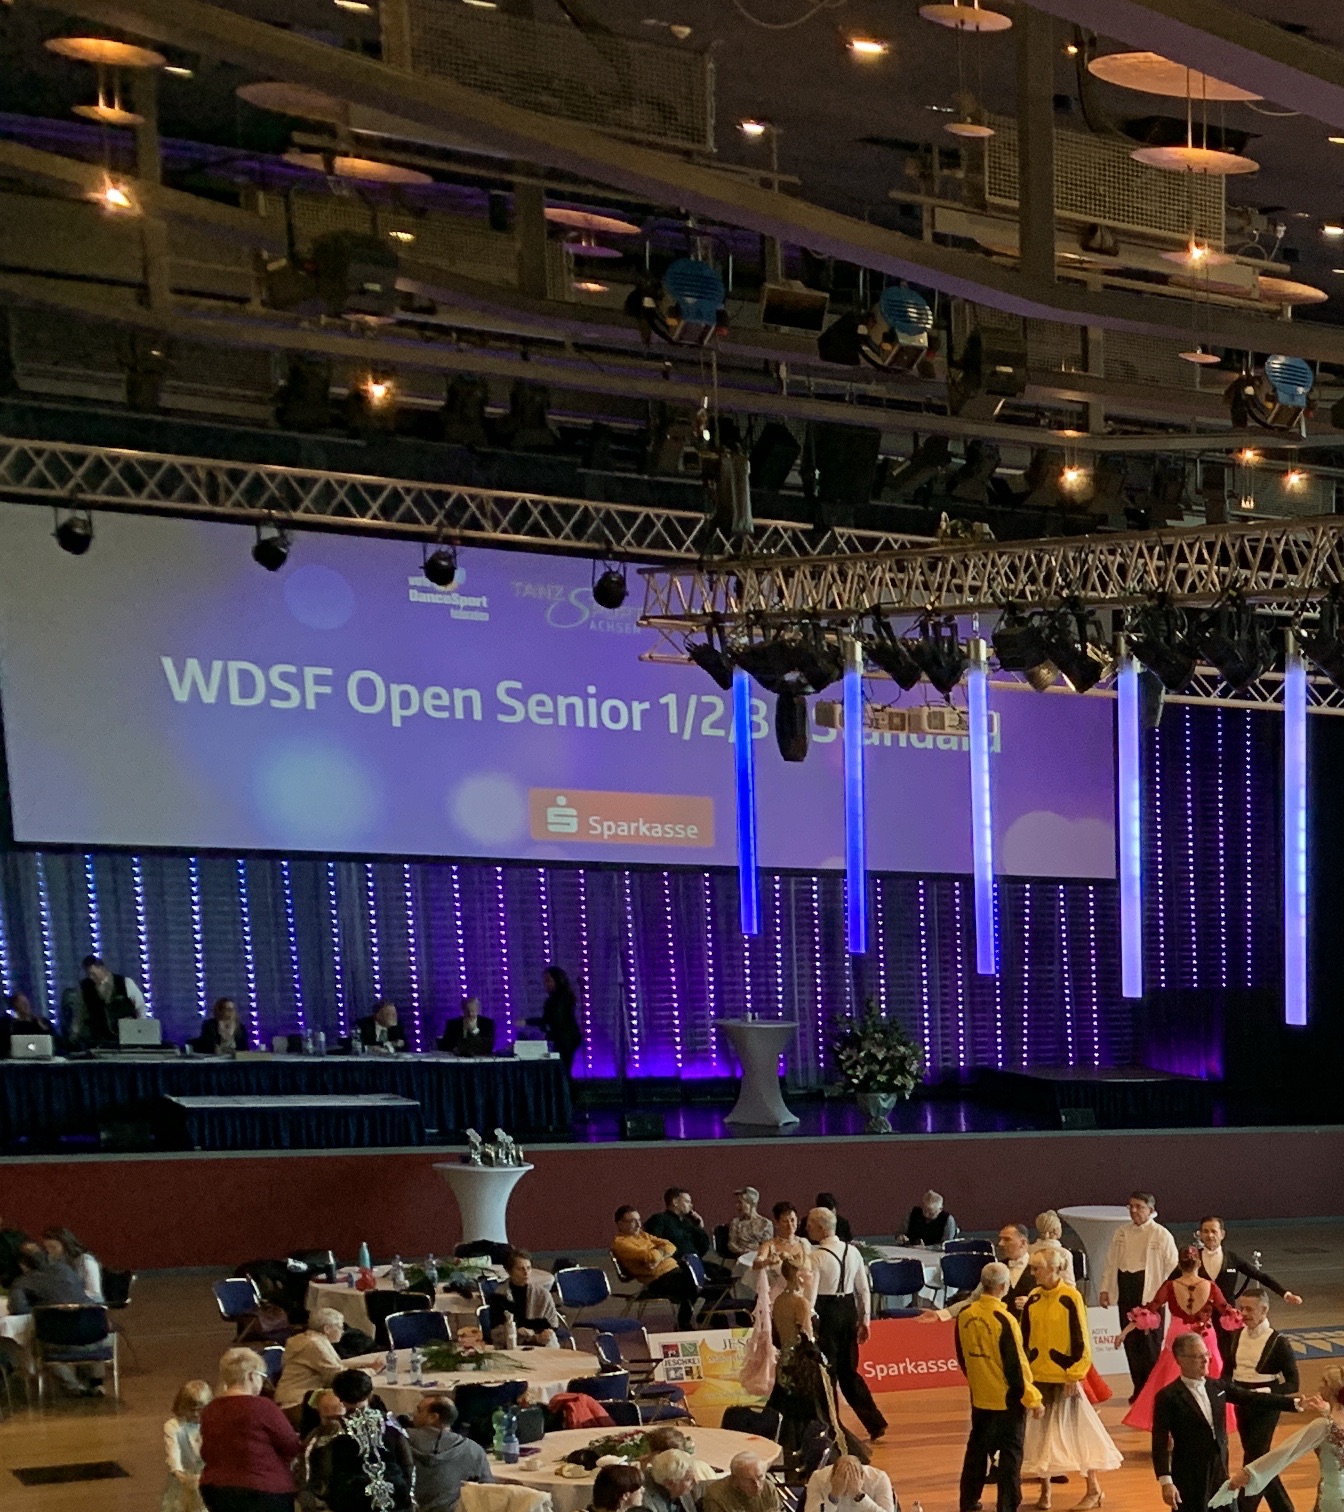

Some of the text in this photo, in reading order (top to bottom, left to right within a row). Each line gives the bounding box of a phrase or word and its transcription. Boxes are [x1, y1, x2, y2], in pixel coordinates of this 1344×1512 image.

[408, 589, 488, 610] DanceSport
[160, 655, 334, 710] WDSF
[347, 670, 482, 727] Open
[497, 680, 651, 731] Senior
[589, 815, 699, 839] Sparkasse
[863, 1356, 958, 1381] Sparkasse
